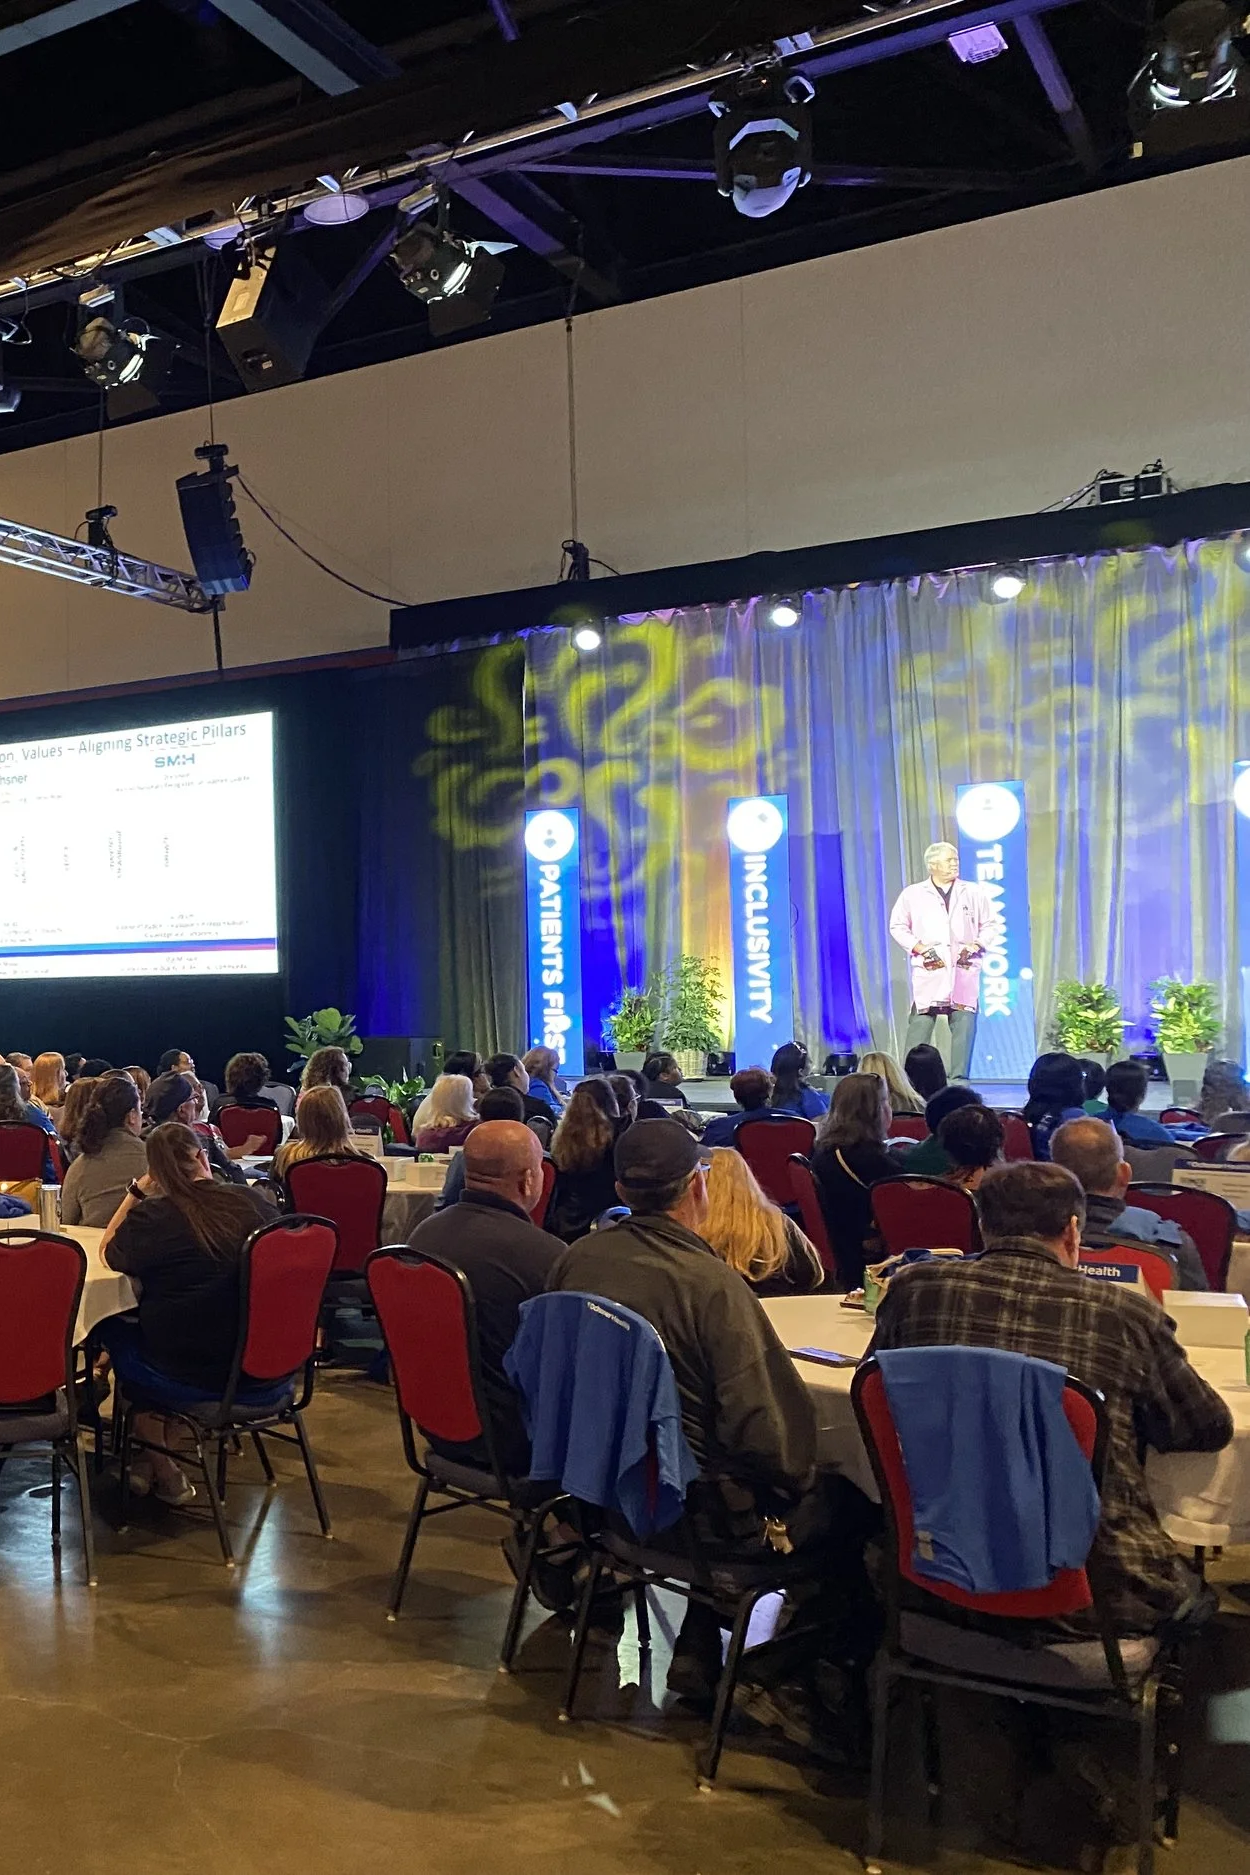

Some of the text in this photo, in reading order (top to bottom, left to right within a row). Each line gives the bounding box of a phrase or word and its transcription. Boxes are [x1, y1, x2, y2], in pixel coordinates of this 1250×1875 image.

[22, 745, 63, 760] Values
[78, 738, 132, 755] Aligning
[136, 728, 198, 747] Strategic
[202, 723, 247, 739] Pillars
[539, 864, 564, 986] PATIENTS
[744, 854, 773, 1024] INCLUSIVITY
[1077, 1264, 1121, 1277] Health
